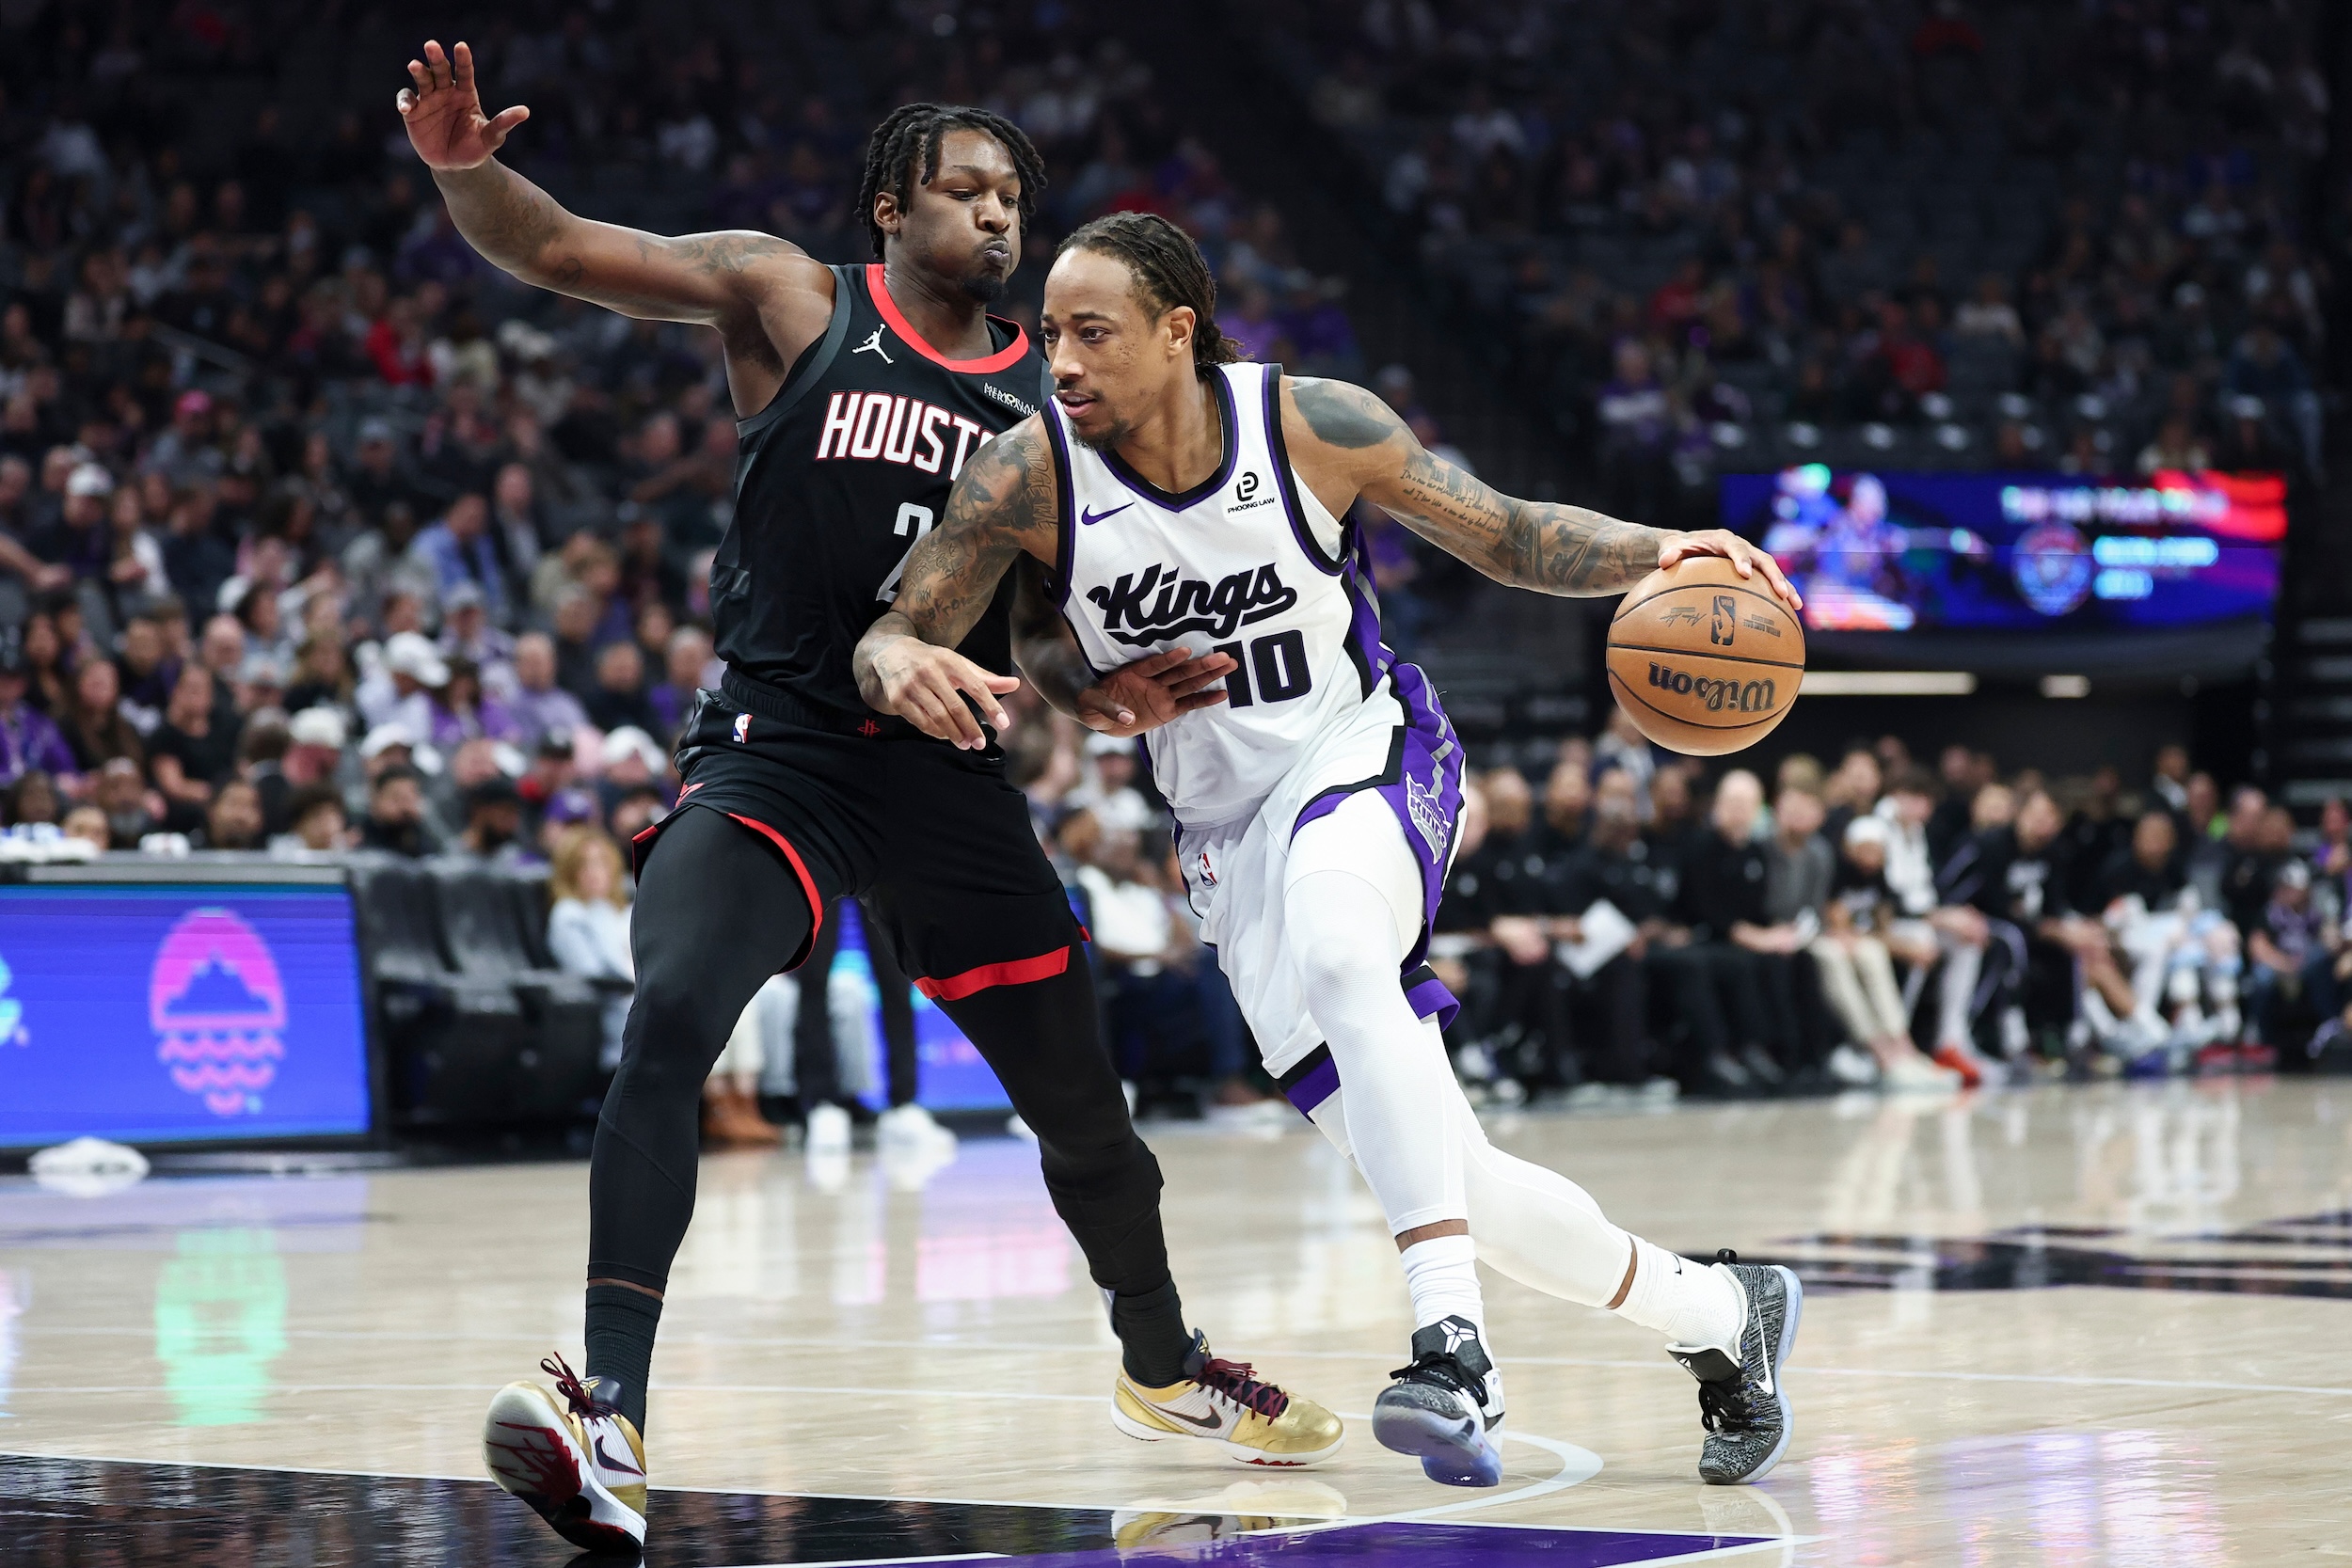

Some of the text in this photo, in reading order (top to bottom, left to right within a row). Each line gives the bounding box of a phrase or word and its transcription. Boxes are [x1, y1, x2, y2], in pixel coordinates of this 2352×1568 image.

[816, 390, 995, 482] HOUST
[1228, 498, 1275, 514] PHOONG LAW
[1086, 562, 1297, 648] Kings
[1213, 629, 1312, 709] 10
[1648, 661, 1775, 712] Wilson
